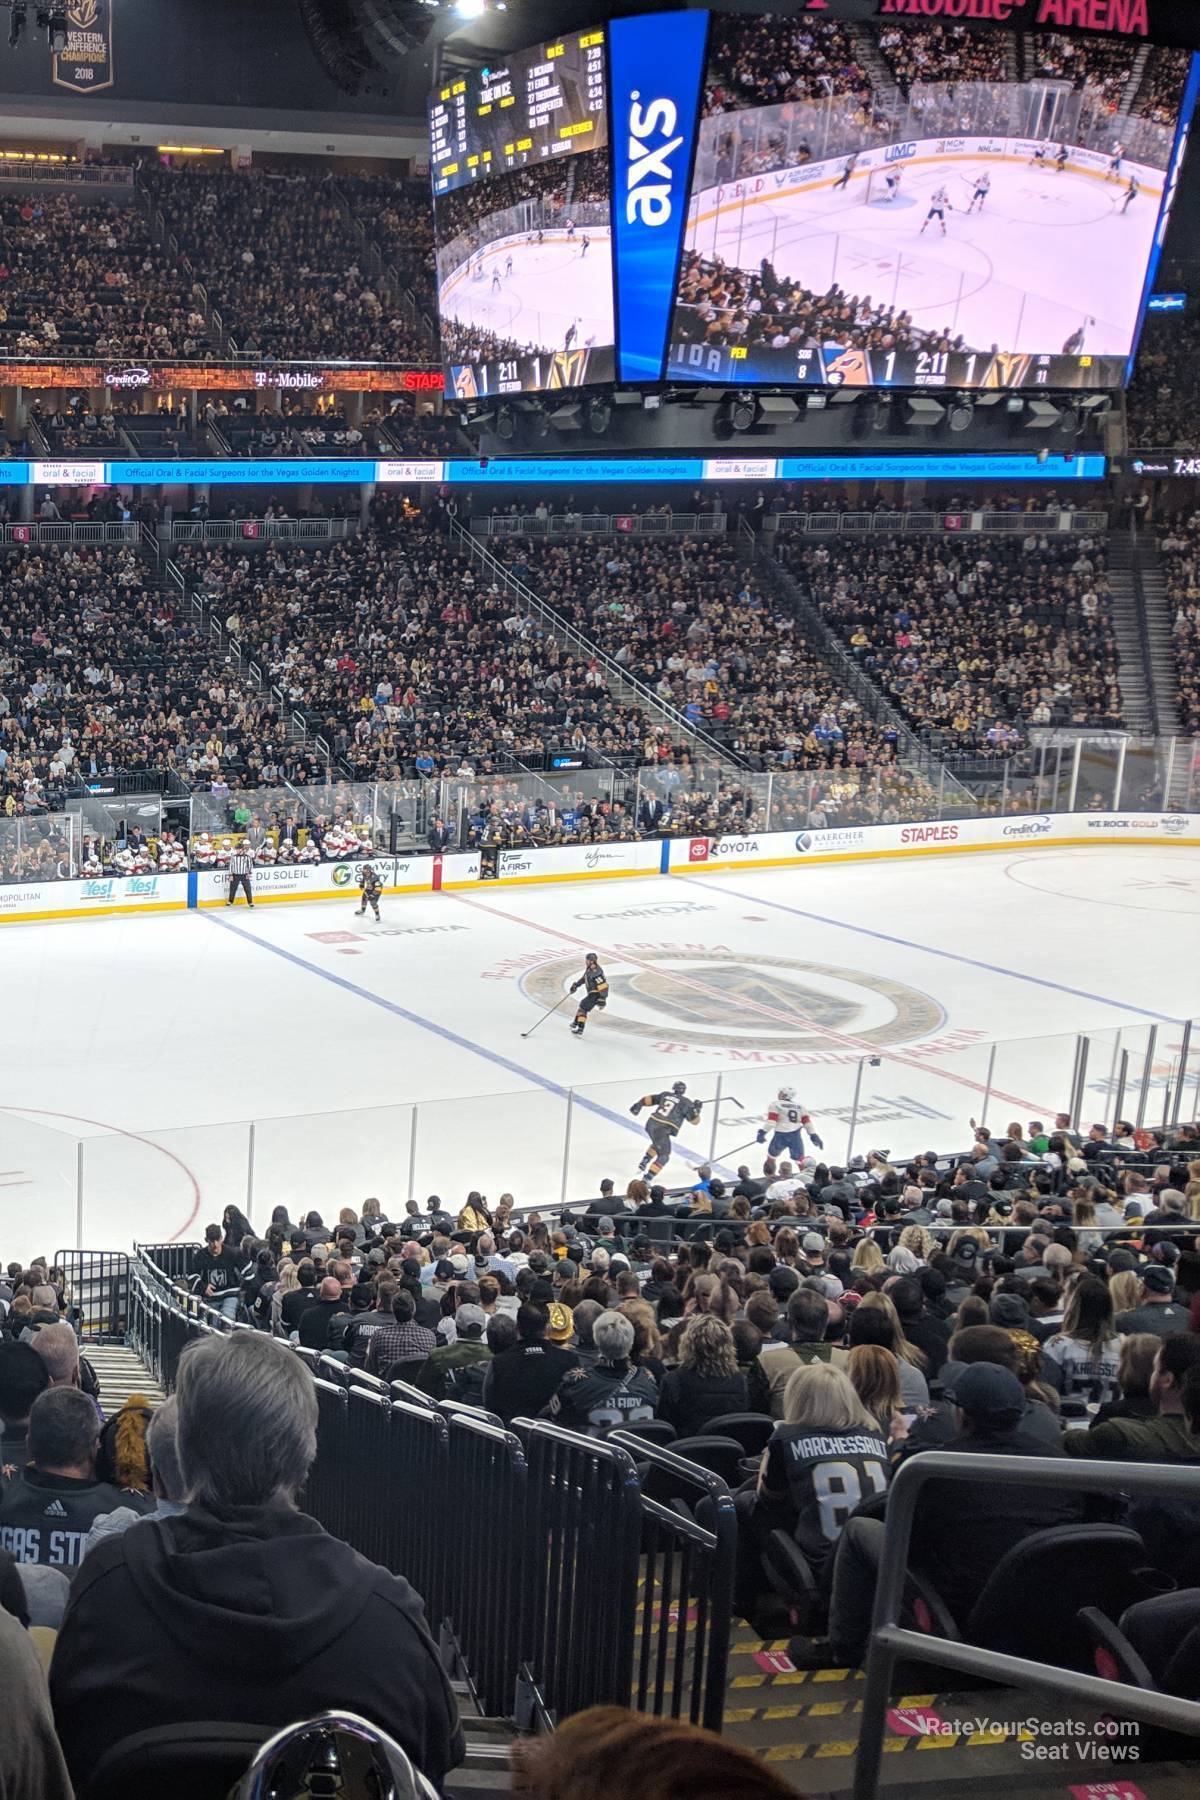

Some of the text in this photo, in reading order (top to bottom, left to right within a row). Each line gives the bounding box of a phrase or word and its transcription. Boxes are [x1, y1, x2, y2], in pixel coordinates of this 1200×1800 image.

[1036, 0, 1150, 36] ARENA
[60, 51, 107, 64] CHAMPIONS
[74, 67, 94, 80] 2018
[884, 143, 917, 163] UMC
[626, 97, 684, 227] axs
[884, 351, 896, 381] 1
[914, 351, 949, 375] 2:11
[965, 354, 977, 384] 1
[498, 360, 518, 382] 2:11
[533, 357, 541, 388] 1
[798, 365, 807, 379] 8
[1036, 369, 1048, 384] 11
[481, 364, 488, 394] 1
[42, 468, 96, 478] oral & facial
[125, 467, 360, 481] Official Oral & Facial Surgeons for the Vegas Golden Knights
[387, 467, 436, 476] oral & facial
[715, 464, 768, 473] oral & facial
[797, 461, 1059, 475] Official Oral & Facial Surgeons for the Vegas Golden Knights
[1002, 822, 1050, 836] CreditOne
[1088, 820, 1158, 828] WE ROCK GOLD
[814, 830, 864, 842] KAERCHER
[900, 824, 959, 844] STAPLES
[507, 861, 533, 871] FIRST
[255, 869, 309, 881] DU SOLEIL
[86, 879, 115, 899] Yes!
[129, 876, 157, 896] Yes!
[613, 941, 732, 952] ARENA
[659, 1099, 675, 1117] 3
[790, 1435, 888, 1462] MARCHESSAULT
[812, 1460, 888, 1542] 81
[763, 1650, 787, 1660] ROW
[768, 1656, 798, 1674] U
[891, 1707, 919, 1717] ROW
[1087, 1782, 1120, 1794] ROW
